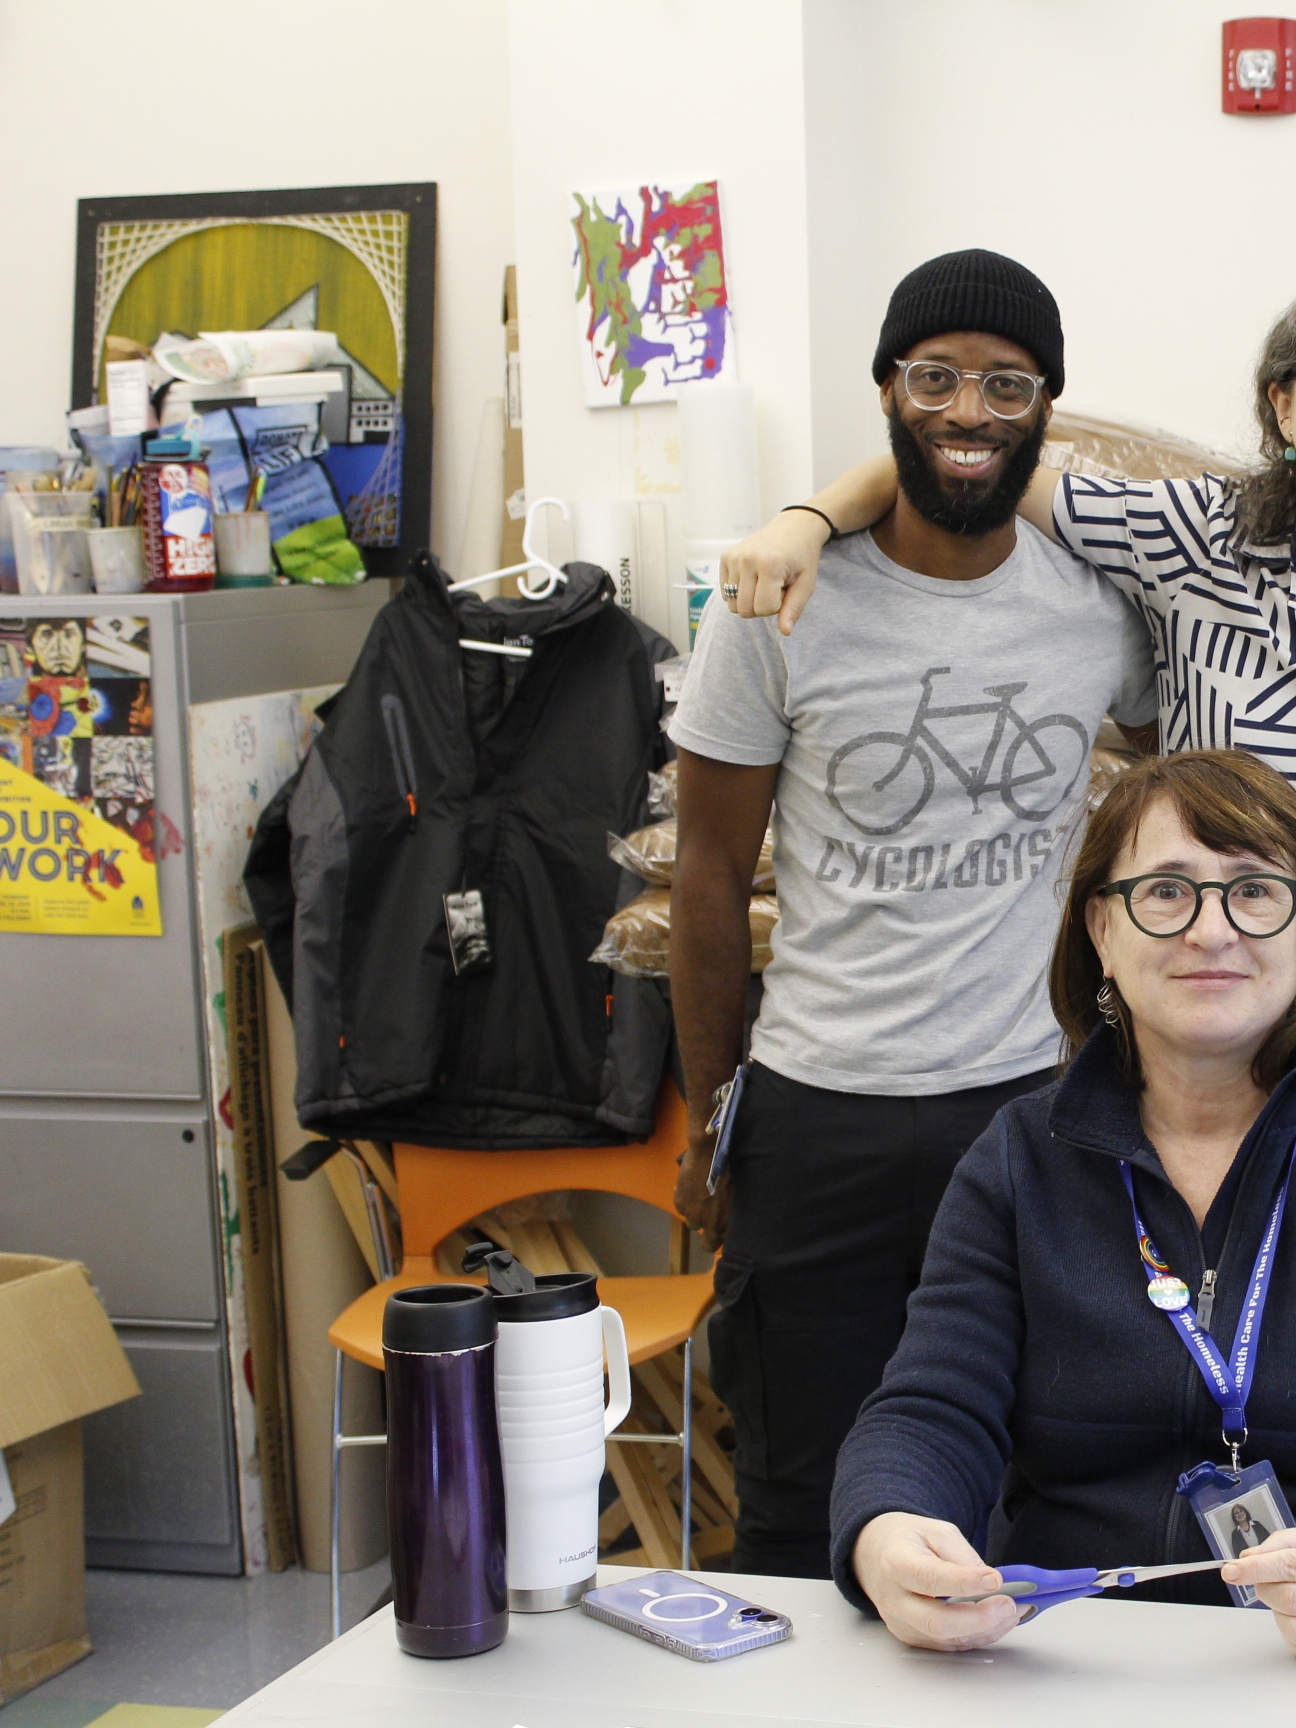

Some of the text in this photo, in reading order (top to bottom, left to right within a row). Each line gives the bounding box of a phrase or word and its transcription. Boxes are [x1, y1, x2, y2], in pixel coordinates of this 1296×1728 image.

[0, 848, 125, 883] WORK
[1150, 1277, 1182, 1288] JUST
[1235, 1187, 1284, 1387] ealth Care For The Homeless
[1155, 1296, 1187, 1307] LOVE
[1179, 1313, 1229, 1394] The Homeless
